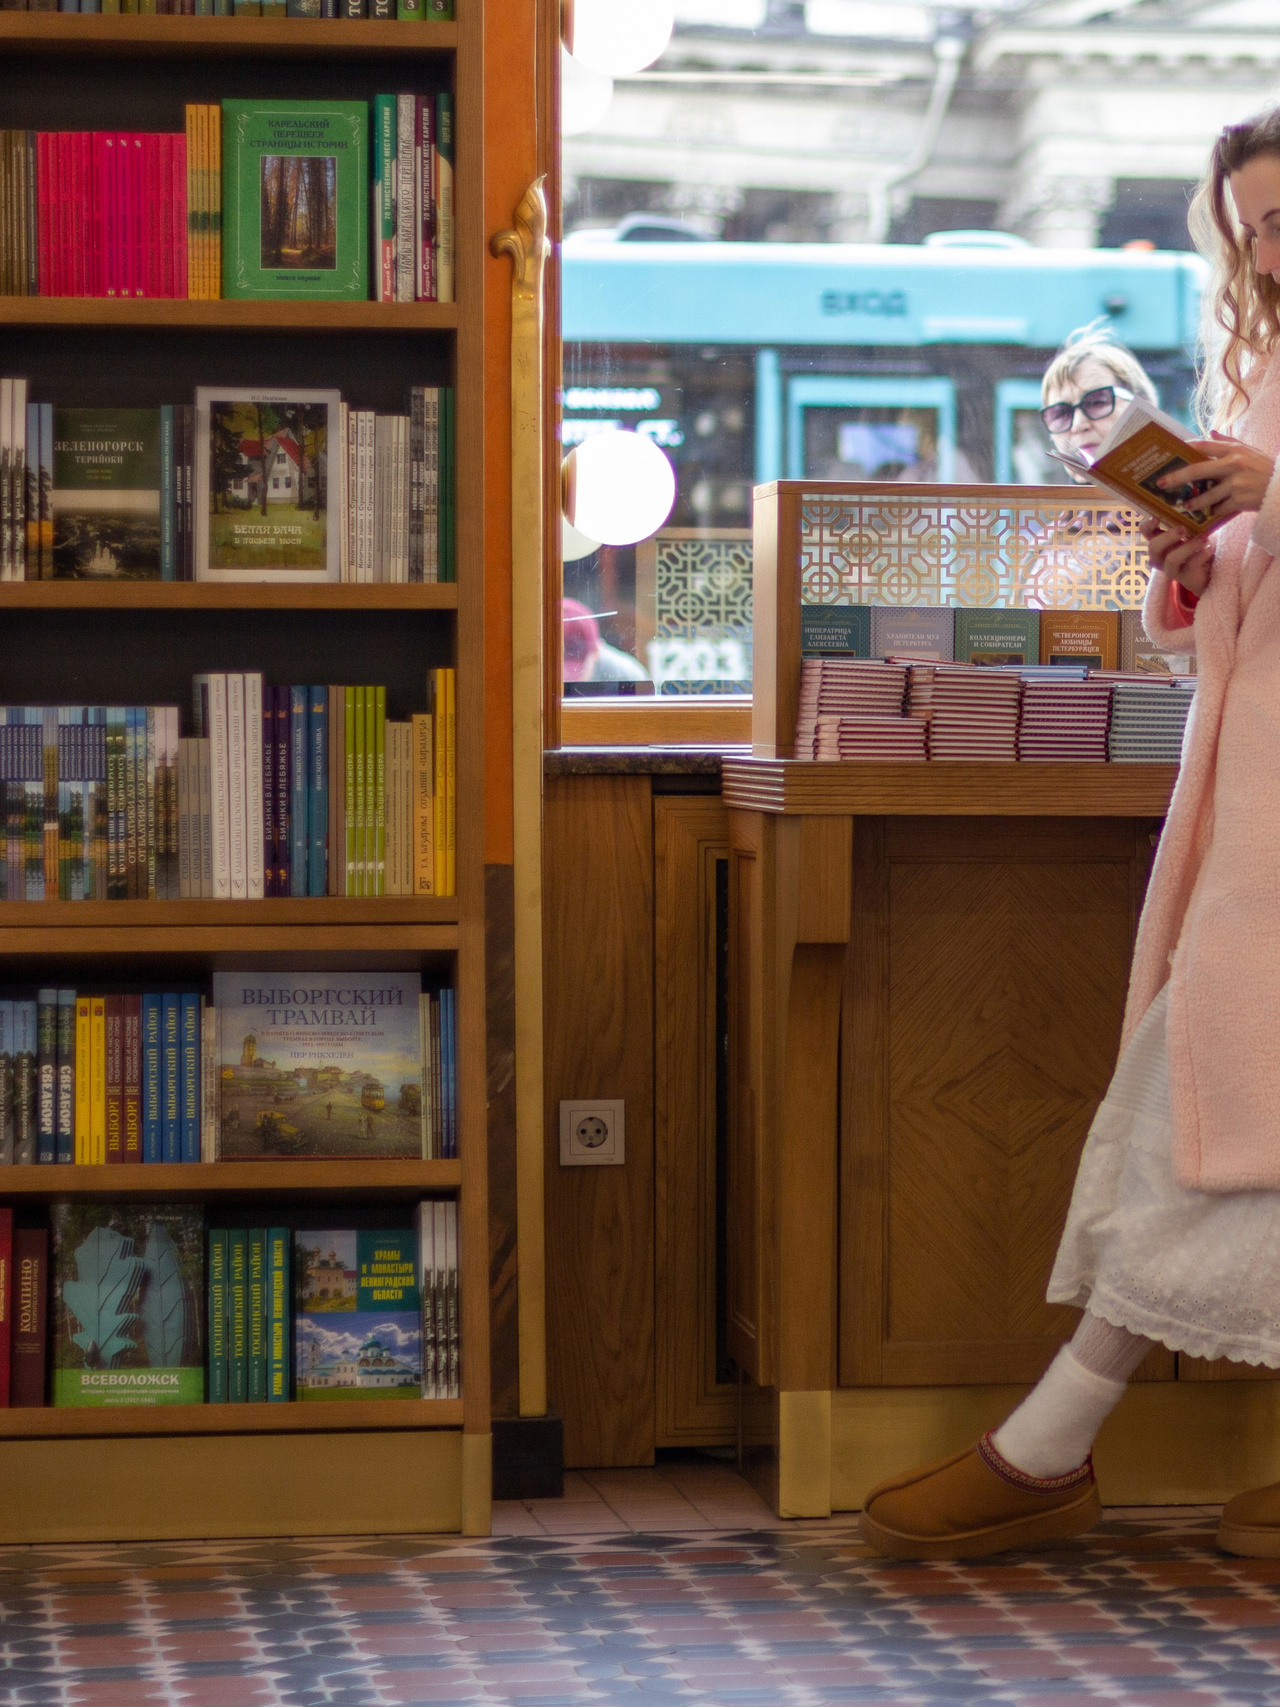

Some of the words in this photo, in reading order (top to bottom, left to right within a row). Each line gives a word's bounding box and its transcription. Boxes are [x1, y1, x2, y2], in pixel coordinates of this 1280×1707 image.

[406, 0, 415, 10] 3
[435, 1, 444, 11] 3
[267, 120, 330, 130] КАРЕЛЬСКИЙ
[273, 130, 325, 139] ПЕРЕШЕЕК
[383, 106, 391, 138] КАРЕЛИИ
[422, 108, 430, 139] КАРЕЛИИ
[249, 140, 301, 150] СТРАНИЦЫ
[303, 140, 348, 149] ИСТОРИИ
[383, 138, 391, 157] МЕСТ
[422, 140, 430, 158] МЕСТ
[400, 139, 413, 185] ПЕРЕШЕЙКА
[383, 158, 391, 210] ТАИНСТВЕННЫХ
[422, 159, 430, 211] ТАИНСТВЕННЫХ
[383, 211, 391, 220] 70
[400, 189, 413, 243] КАРЕЛЬСКОГО
[422, 212, 430, 221] 70
[383, 246, 391, 269] Сыров
[400, 247, 413, 275] ХРАМЫ
[423, 247, 431, 270] Сыров
[383, 270, 391, 296] Андрей
[423, 271, 431, 298] Андрей
[54, 441, 144, 452] ЗЕЛЕНОГОРСК
[74, 454, 123, 464] ТЕРИЙОКИ
[233, 525, 271, 534] БЕЛАЯ
[272, 525, 302, 535] ДАЧА
[804, 627, 852, 635] ИМПЕРАТРИЦА
[969, 634, 1027, 642] КОЛЛЕКЦИОНЕРЫ
[980, 641, 1022, 649] СОБИРАТЕЛИ
[1052, 645, 1100, 653] ПЕТЕРБУРЖЦЕВ
[215, 714, 225, 769] НЕИЗВЕСТНЫЕ
[233, 715, 242, 770] НЕИЗВЕСТНЫЕ
[264, 743, 273, 790] ЛЕБЯЖЬЕ
[108, 781, 116, 811] СТАРУЮ
[127, 784, 135, 799] ДО
[137, 783, 146, 798] ДО
[217, 769, 226, 826] ОКРЕСТНОСТИ
[234, 770, 242, 827] ОКРЕСТНОСТИ
[127, 800, 136, 848] БАЛТИКИ
[138, 799, 146, 847] БАЛТИКИ
[192, 814, 200, 846] ТИХВИН
[264, 799, 273, 840] БИАНКИ
[108, 818, 116, 873] ПУТЕШЕСТВИЕ
[128, 850, 136, 864] ОТ
[139, 848, 146, 863] ОТ
[218, 827, 227, 873] ПЕТЕРБУРГА
[234, 828, 243, 874] ПЕТЕРБУРГА
[192, 848, 200, 880] СТАРЫЙ
[240, 986, 404, 1006] ВЫБОРГСКИЙ
[146, 1007, 158, 1043] РАЙОН
[165, 1007, 177, 1042] РАЙОН
[266, 1006, 377, 1026] ТРАМВАЙ
[22, 1058, 28, 1066] Из
[290, 1051, 308, 1059] ПЕР
[308, 1051, 354, 1059] РИКХЕДЕН
[20, 1068, 29, 1105] Петербурга
[146, 1048, 158, 1120] ВЫБОРГСКИЙ
[165, 1048, 177, 1120] ВЫБОРГСКИЙ
[59, 1064, 71, 1135] СВЕАБОРГ
[108, 1098, 120, 1151] ВЫБОРГ
[126, 1098, 138, 1151] ВЫБОРГ
[212, 1243, 223, 1280] РАЙОН
[232, 1244, 244, 1280] РАЙОН
[273, 1240, 283, 1267] ОБЛАСТИ
[374, 1250, 401, 1261] ХРАМЫ
[360, 1274, 415, 1288] ЛЕНИНГРАДСКОЙ
[362, 1263, 367, 1274] И
[371, 1262, 413, 1274] МОНАСТЫРИ
[20, 1258, 32, 1333] КОЛПИНО
[273, 1270, 283, 1319] ЛЕНИНГРАДСКОЙ
[372, 1289, 403, 1300] ОБЛАСТИ
[212, 1285, 223, 1358] ТОСНЕНСКИЙ
[232, 1285, 244, 1359] ТОСНЕНСКИЙ
[273, 1322, 283, 1360] МОНАСТЫРИ
[81, 1374, 179, 1386] ВСЕВОЛОЖСК
[273, 1372, 283, 1396] ХРАМЫ
